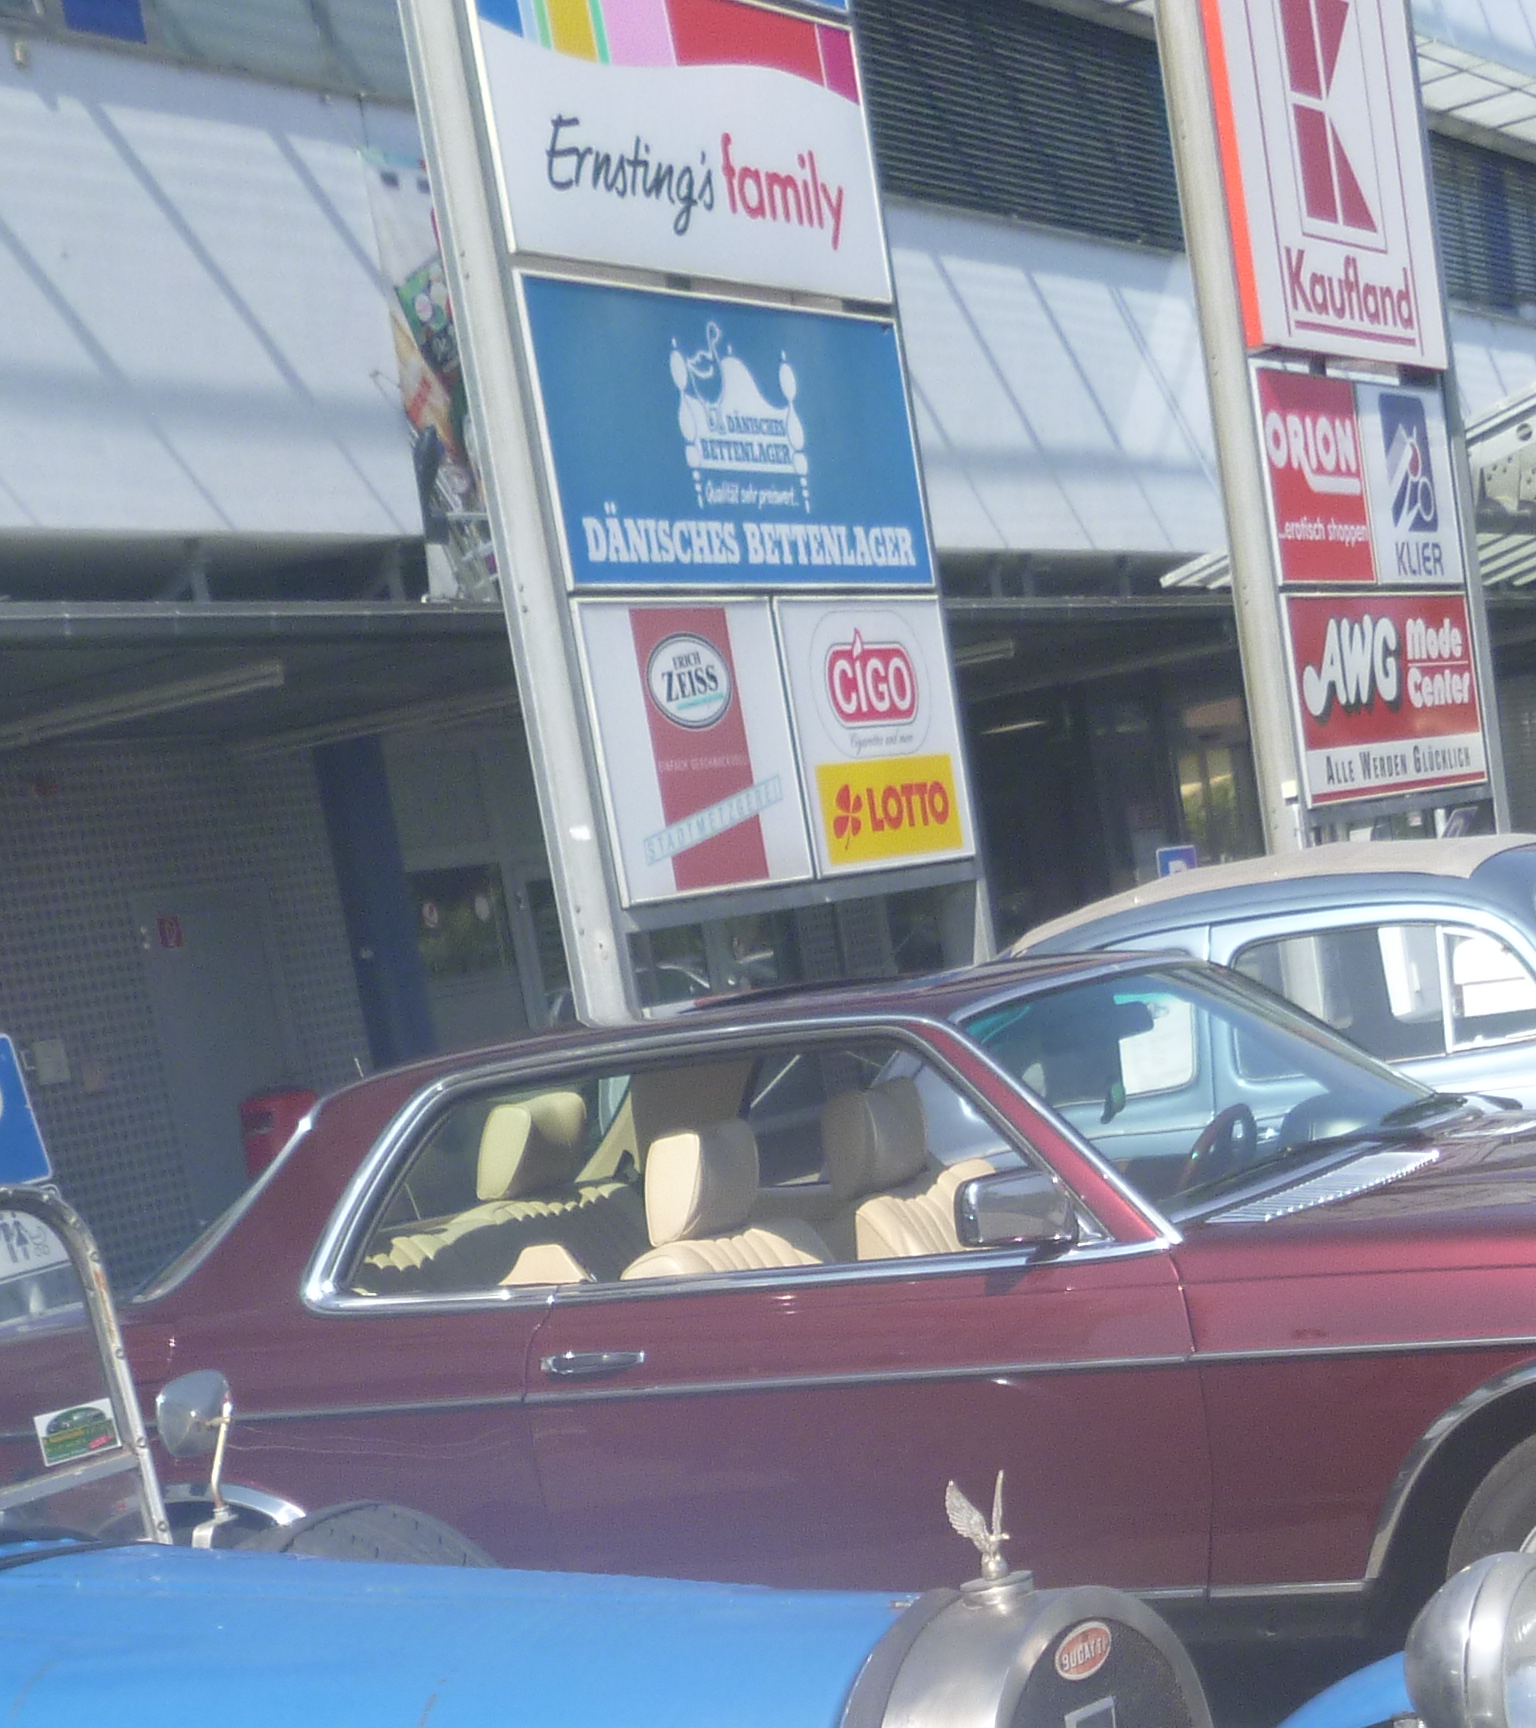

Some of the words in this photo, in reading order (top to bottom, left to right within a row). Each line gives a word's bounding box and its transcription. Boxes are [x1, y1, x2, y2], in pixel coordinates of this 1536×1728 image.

[546, 114, 714, 236] Ernsting's
[721, 132, 843, 251] family
[1284, 246, 1414, 330] Kaufland
[726, 411, 786, 436] DÄNISCHES
[700, 438, 791, 465] BETTENLAGER
[1264, 411, 1360, 490] ORION
[582, 501, 741, 563] DÄNISCHES
[743, 522, 916, 566] BETTENLAGER
[1327, 519, 1369, 548] shoppen
[1395, 541, 1444, 577] KLIER
[1406, 617, 1462, 660] Mode
[672, 651, 701, 668] ERICH
[1303, 614, 1401, 722] AWG
[661, 664, 719, 702] ZEISS
[1407, 666, 1470, 708] Center
[1326, 755, 1355, 785] ALLE
[1359, 750, 1408, 780] WERDEN
[1414, 745, 1470, 774] GLÜCKLICH
[866, 780, 949, 832] LOTTO
[1061, 1637, 1109, 1671] BUGATTI
